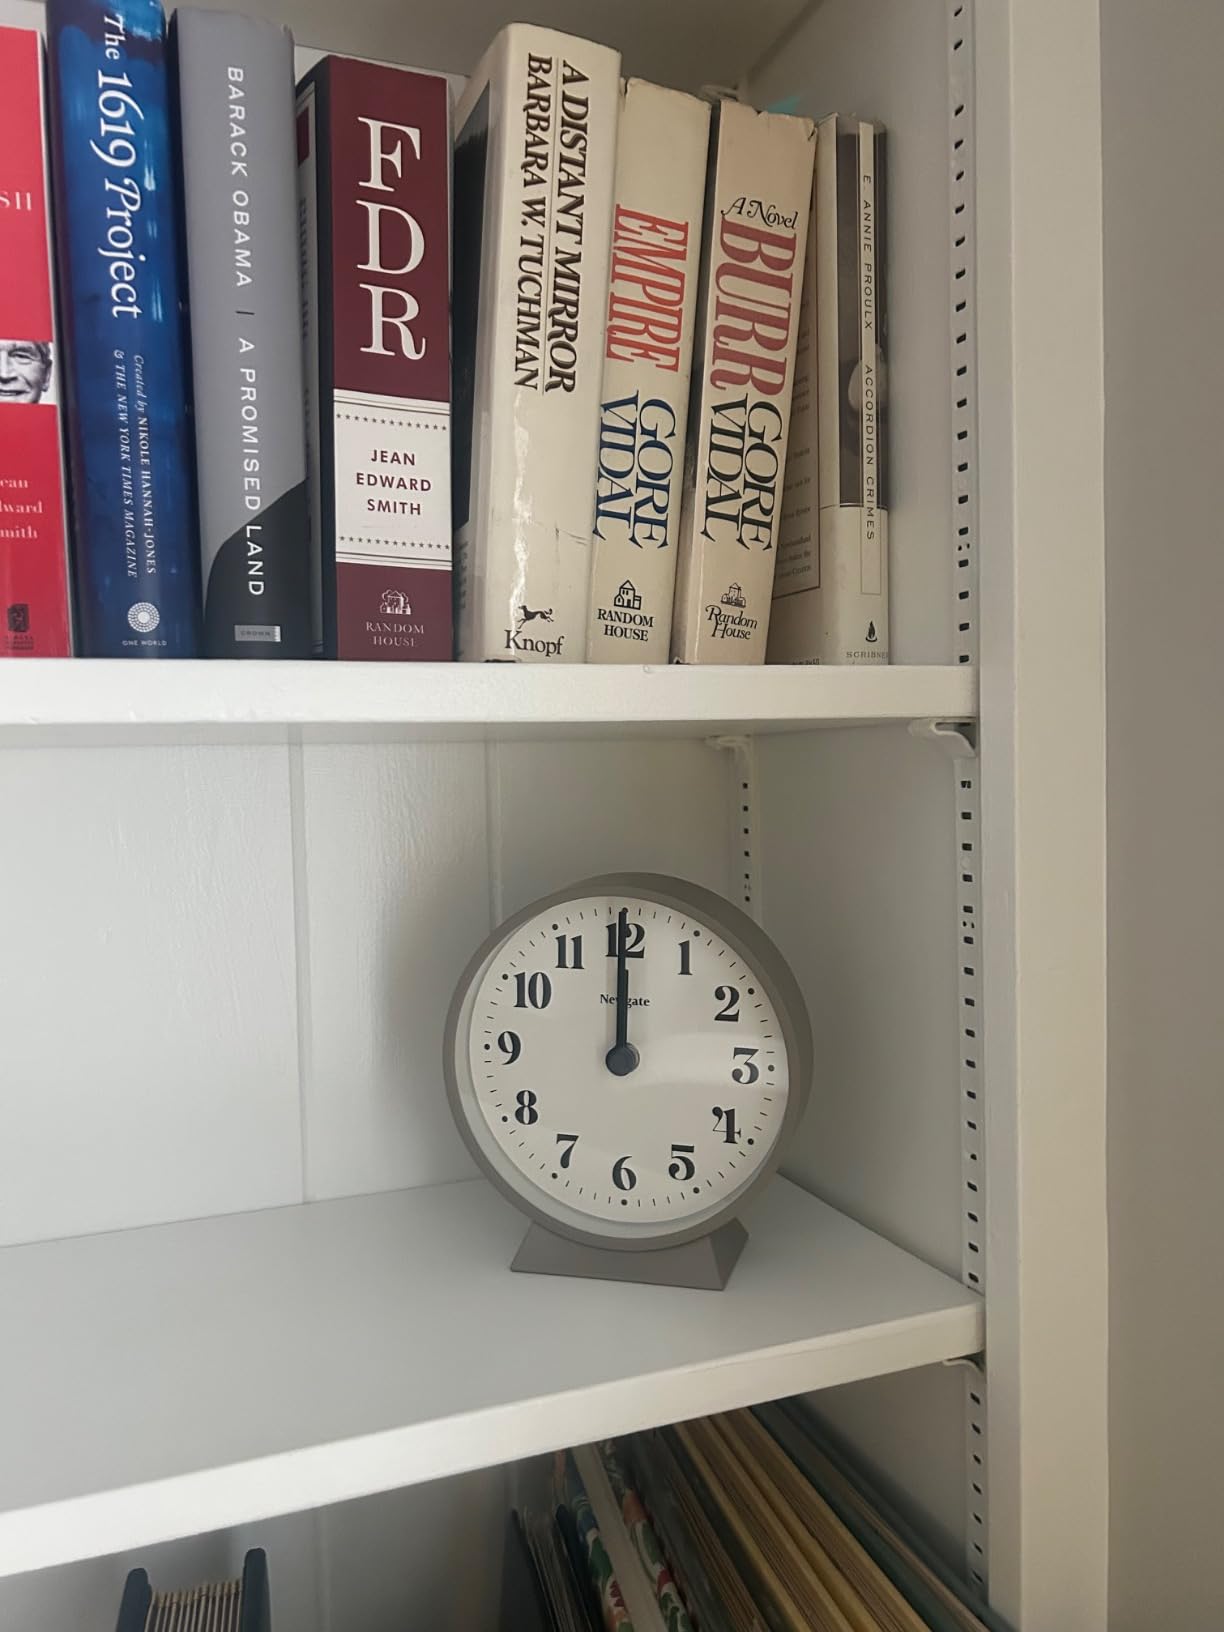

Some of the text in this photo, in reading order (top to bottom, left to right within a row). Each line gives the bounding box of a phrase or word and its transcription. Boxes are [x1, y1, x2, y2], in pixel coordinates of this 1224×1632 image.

[90, 14, 146, 318] The 1619 Project
[227, 66, 253, 287] BARACK OBAMA
[514, 52, 553, 391] BARBARA W. TUCHMAN
[545, 59, 590, 393] A DISTANT MIRROR
[721, 197, 798, 230] A Novel
[863, 200, 872, 252] ANNIE
[606, 203, 689, 373] EMPIRE
[710, 215, 797, 396] BURR
[864, 263, 873, 330] PROULX
[115, 365, 127, 390] THE
[134, 354, 147, 398] Created
[117, 394, 128, 424] NEW
[134, 400, 148, 413] by
[119, 427, 131, 461] YORK
[138, 417, 151, 465] NIKOLE
[371, 449, 415, 466] JEAN
[864, 364, 875, 540] ACCORDION CRIMES
[239, 337, 265, 596] A PROMISED LAND
[356, 472, 432, 492] EDWARD
[593, 390, 639, 541] VIDAL
[629, 398, 676, 549] GORE
[700, 393, 748, 542] VIDAL
[736, 401, 782, 551] GORE
[121, 466, 133, 506] TIMES
[0, 500, 43, 513] ward
[367, 499, 421, 516] SMITH
[124, 509, 138, 578] MAGAZINE
[365, 621, 424, 635] RANDOM
[597, 608, 654, 628] RANDOM
[603, 624, 649, 642] HOUSE
[705, 604, 758, 630] Random
[711, 621, 751, 641] House
[373, 636, 416, 648] HOUSE
[504, 629, 564, 657] Knopf
[555, 934, 585, 969] 11
[605, 922, 645, 958] 12
[678, 940, 693, 976] 1
[513, 971, 552, 1009] 10
[600, 993, 650, 1009] Negate
[714, 985, 741, 1022] 2
[497, 1030, 522, 1065] 9
[731, 1047, 760, 1084] 3
[515, 1090, 539, 1125] 8
[712, 1106, 742, 1144] 4
[555, 1133, 579, 1169] 7
[668, 1144, 695, 1181] 5
[612, 1156, 637, 1191] 6
